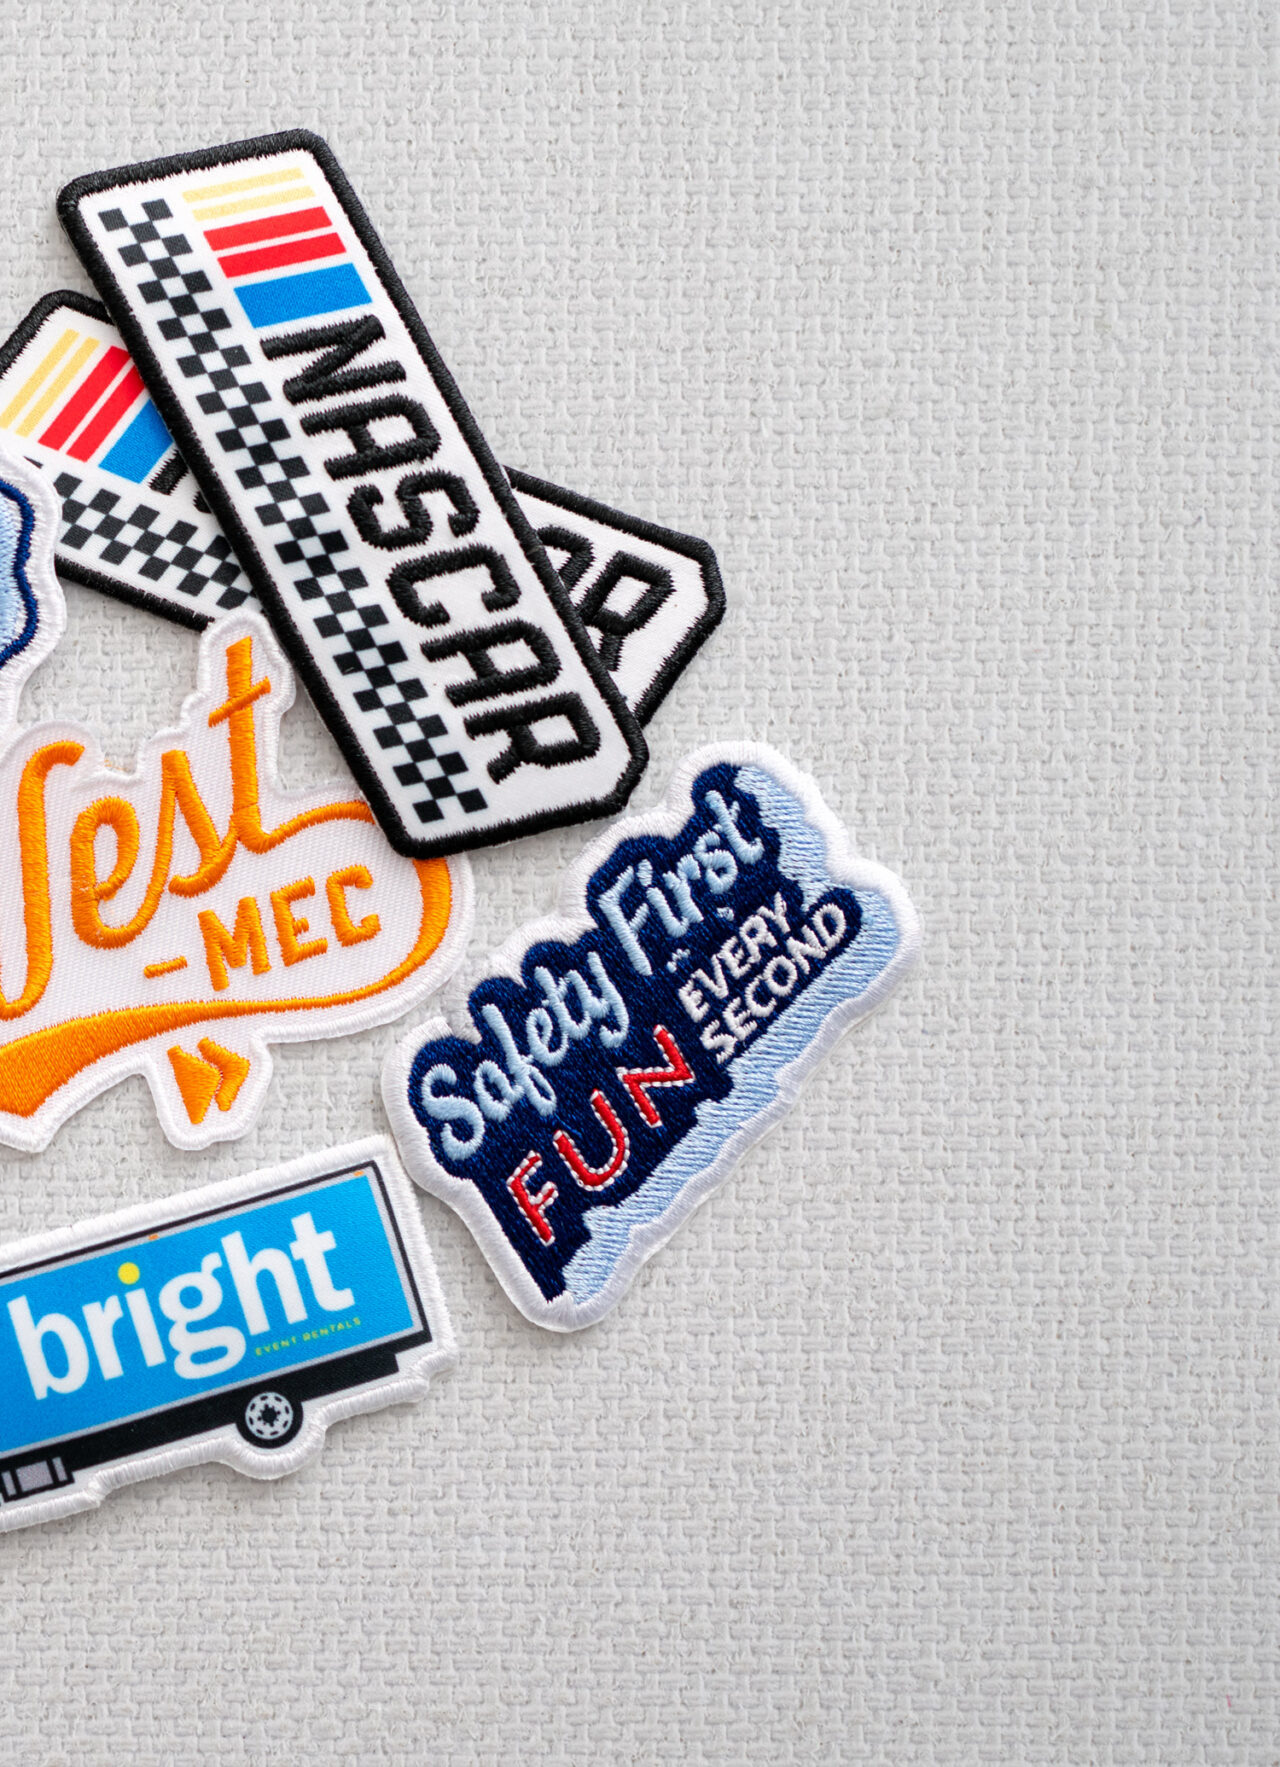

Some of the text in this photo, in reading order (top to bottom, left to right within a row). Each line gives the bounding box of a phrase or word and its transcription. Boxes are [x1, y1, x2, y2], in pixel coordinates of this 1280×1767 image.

[260, 314, 600, 785] NASCAR
[421, 952, 630, 1162] Safety
[596, 789, 763, 976] First
[676, 890, 789, 1023] EVERY
[699, 901, 846, 1065] SECOND
[506, 1023, 696, 1246] FUN
[8, 1212, 355, 1400] bright
[255, 1317, 361, 1356] EVENT RENTALS
